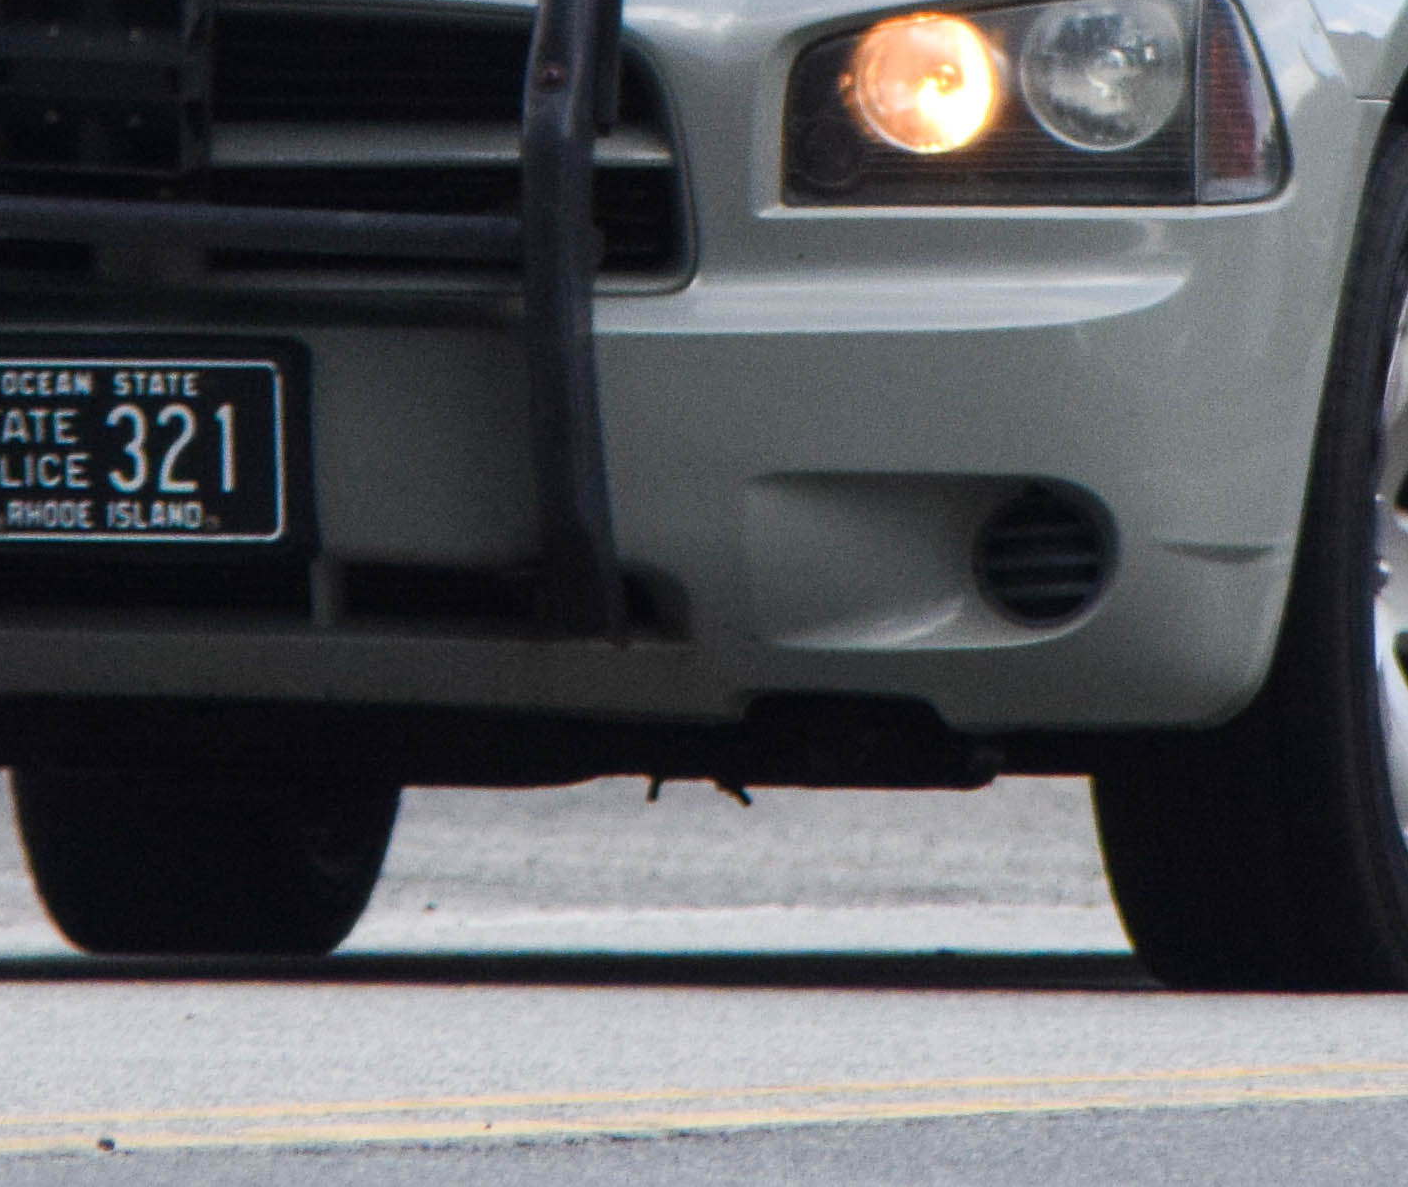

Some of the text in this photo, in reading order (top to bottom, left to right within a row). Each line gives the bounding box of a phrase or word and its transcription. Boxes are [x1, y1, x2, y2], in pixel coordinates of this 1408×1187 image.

[0, 371, 200, 397] OCEAN STATE
[105, 403, 237, 494] 321
[5, 500, 205, 530] RHODE ISLAND
